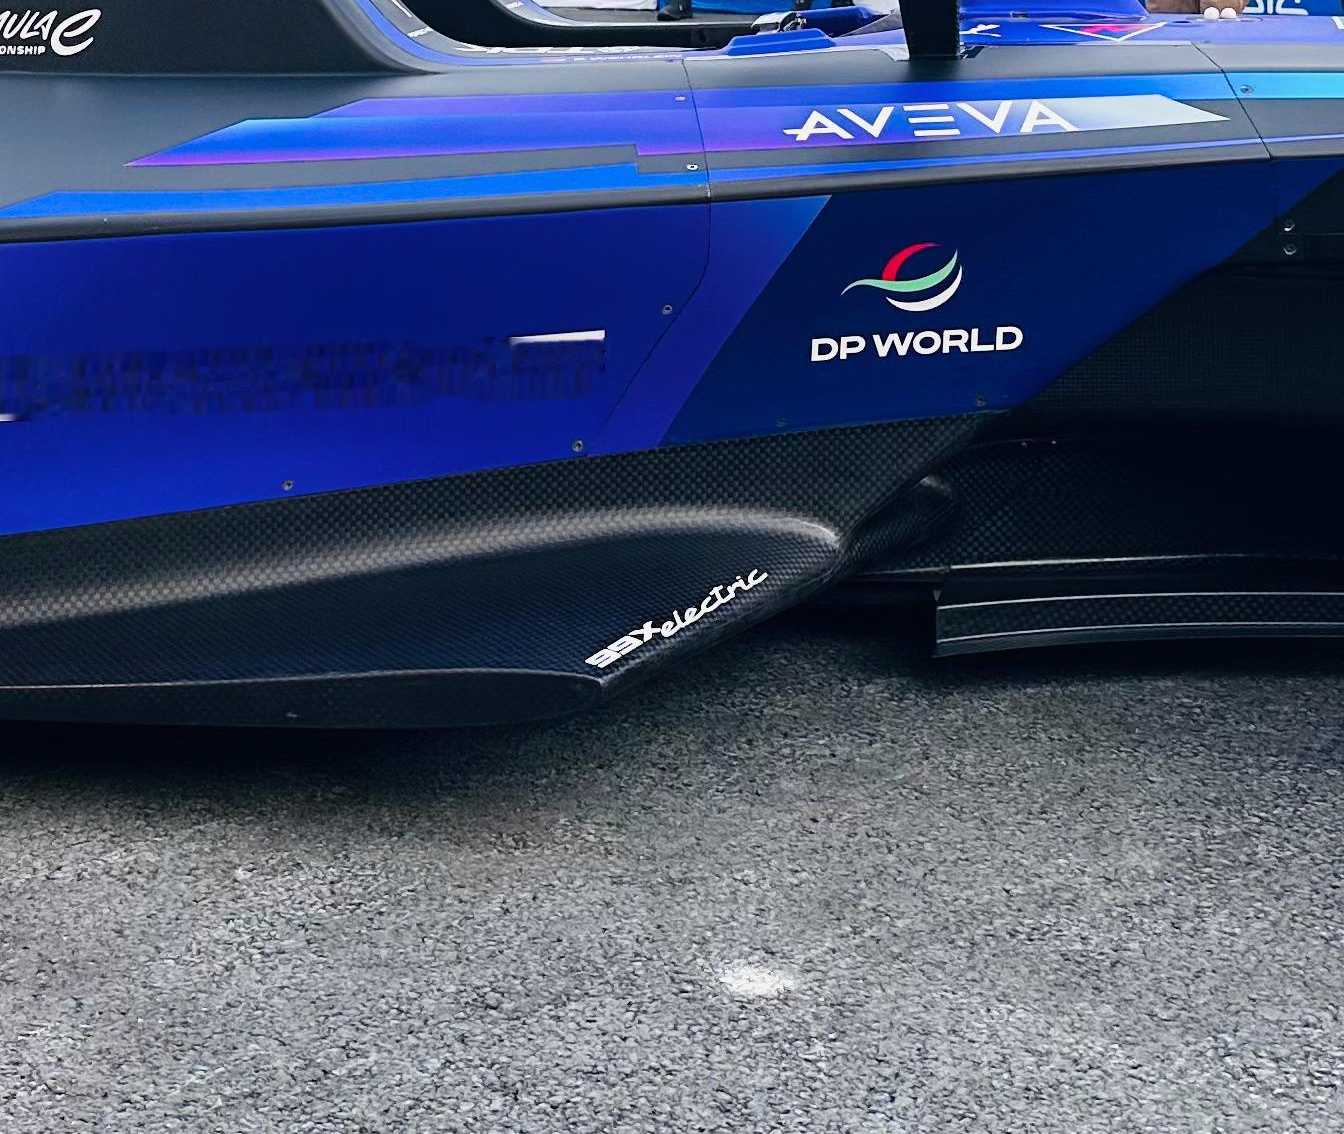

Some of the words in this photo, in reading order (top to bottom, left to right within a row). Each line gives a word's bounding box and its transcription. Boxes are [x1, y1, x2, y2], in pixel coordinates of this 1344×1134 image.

[782, 98, 1080, 142] AVEVA
[810, 335, 866, 362] DP
[872, 325, 1024, 358] WORLD
